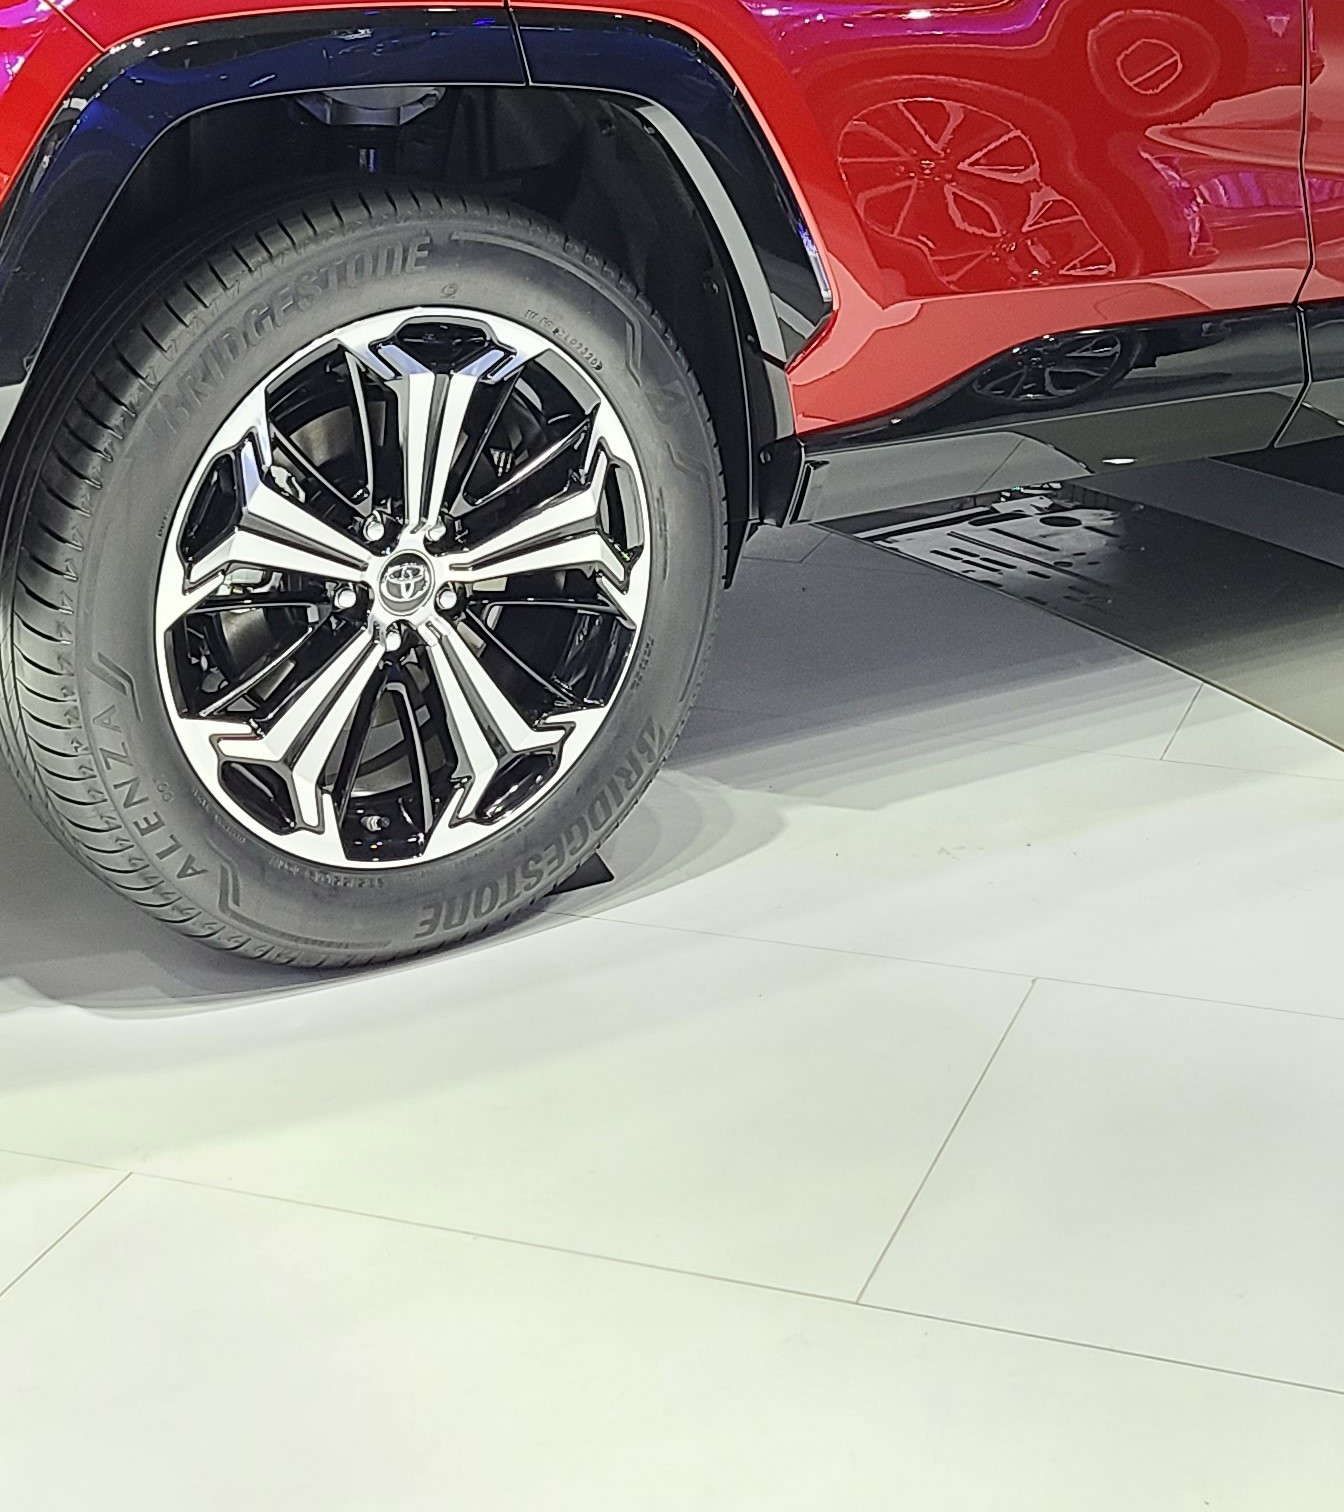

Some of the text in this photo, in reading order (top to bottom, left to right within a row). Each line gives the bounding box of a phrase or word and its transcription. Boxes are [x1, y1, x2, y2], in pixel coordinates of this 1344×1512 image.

[148, 232, 431, 434] BRIDGESTONE
[93, 704, 208, 880] ALENZA
[415, 717, 668, 938] BRIDGESTONE
